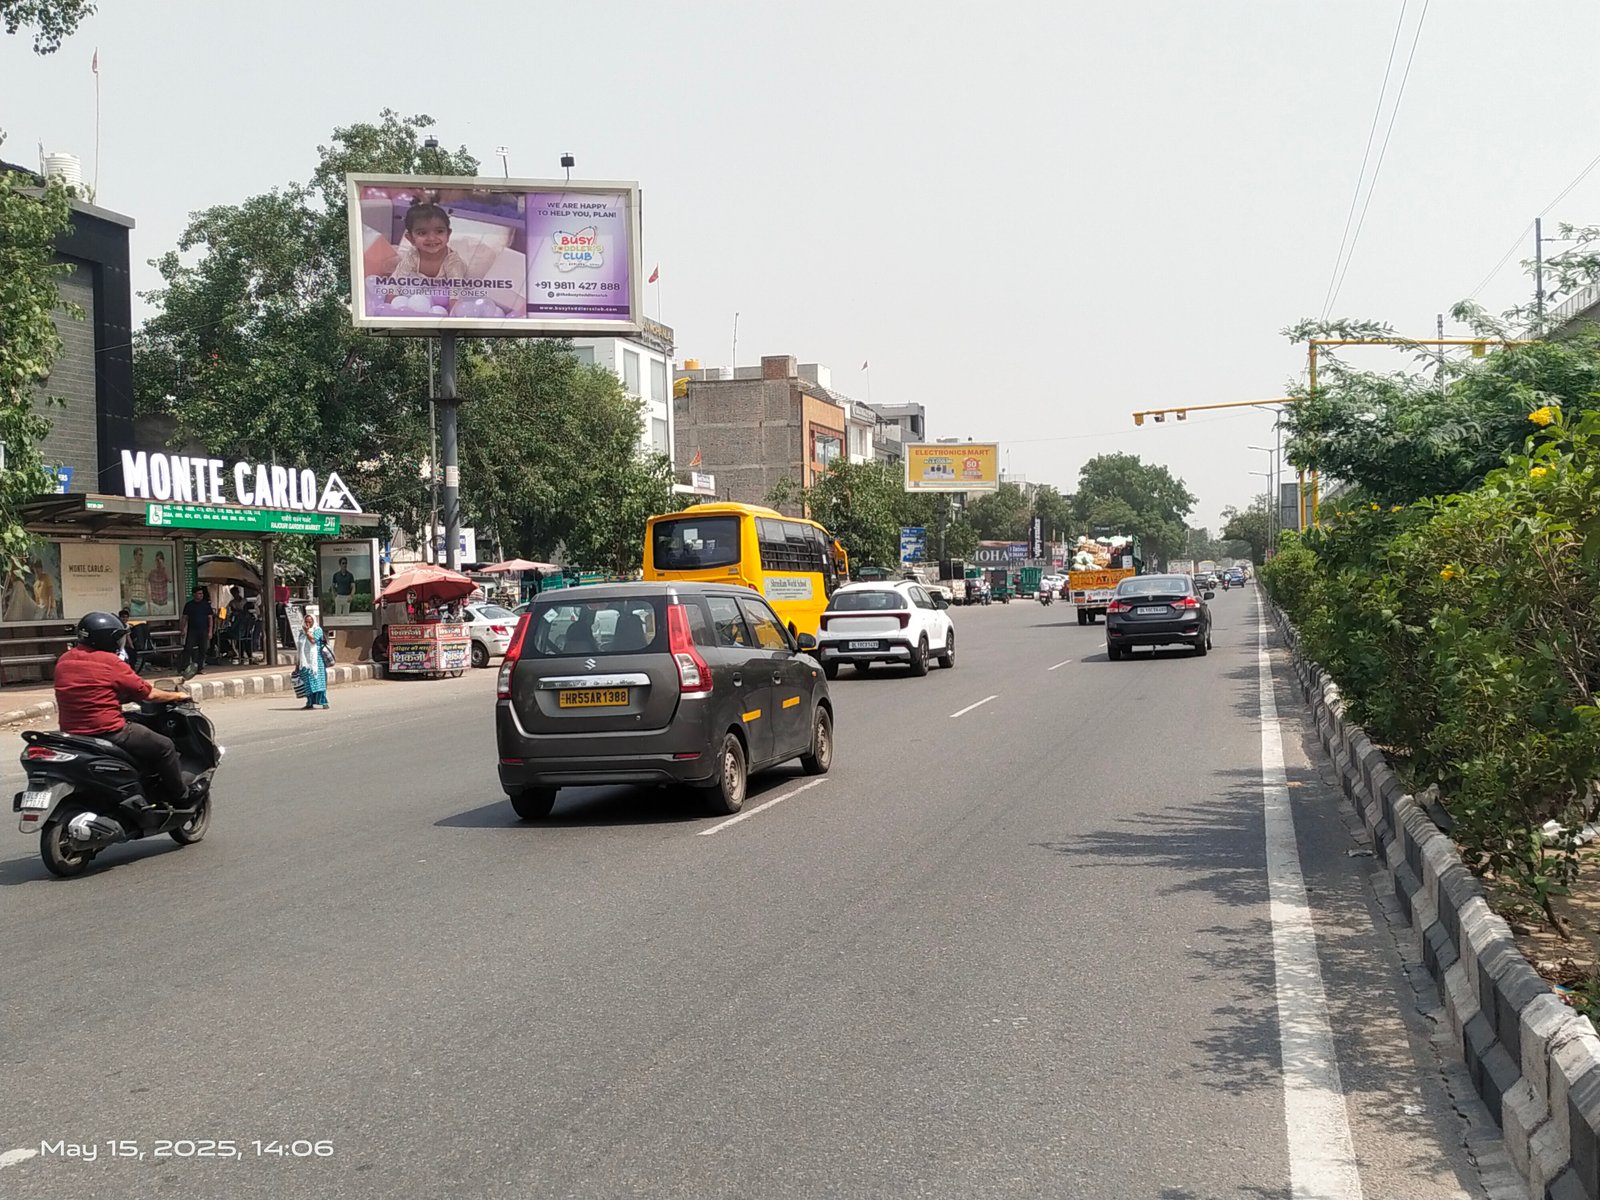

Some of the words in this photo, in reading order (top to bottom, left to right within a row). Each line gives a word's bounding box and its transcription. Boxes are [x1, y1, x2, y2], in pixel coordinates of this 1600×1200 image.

[572, 210, 592, 218] YOU,
[561, 236, 593, 246] BUSY
[562, 252, 593, 261] CLUB
[375, 276, 438, 287] MAGICAL
[441, 279, 512, 289] MEMORIES
[535, 281, 551, 289] +91
[554, 282, 575, 290] 9811
[600, 283, 620, 291] 888
[375, 288, 394, 296] FOR
[425, 289, 458, 297] LITTLES
[121, 450, 226, 503] MONTE
[233, 461, 317, 510] CARLO
[69, 564, 86, 573] MONTE
[87, 564, 104, 573] CARLO
[565, 691, 627, 705] HR55AR1388
